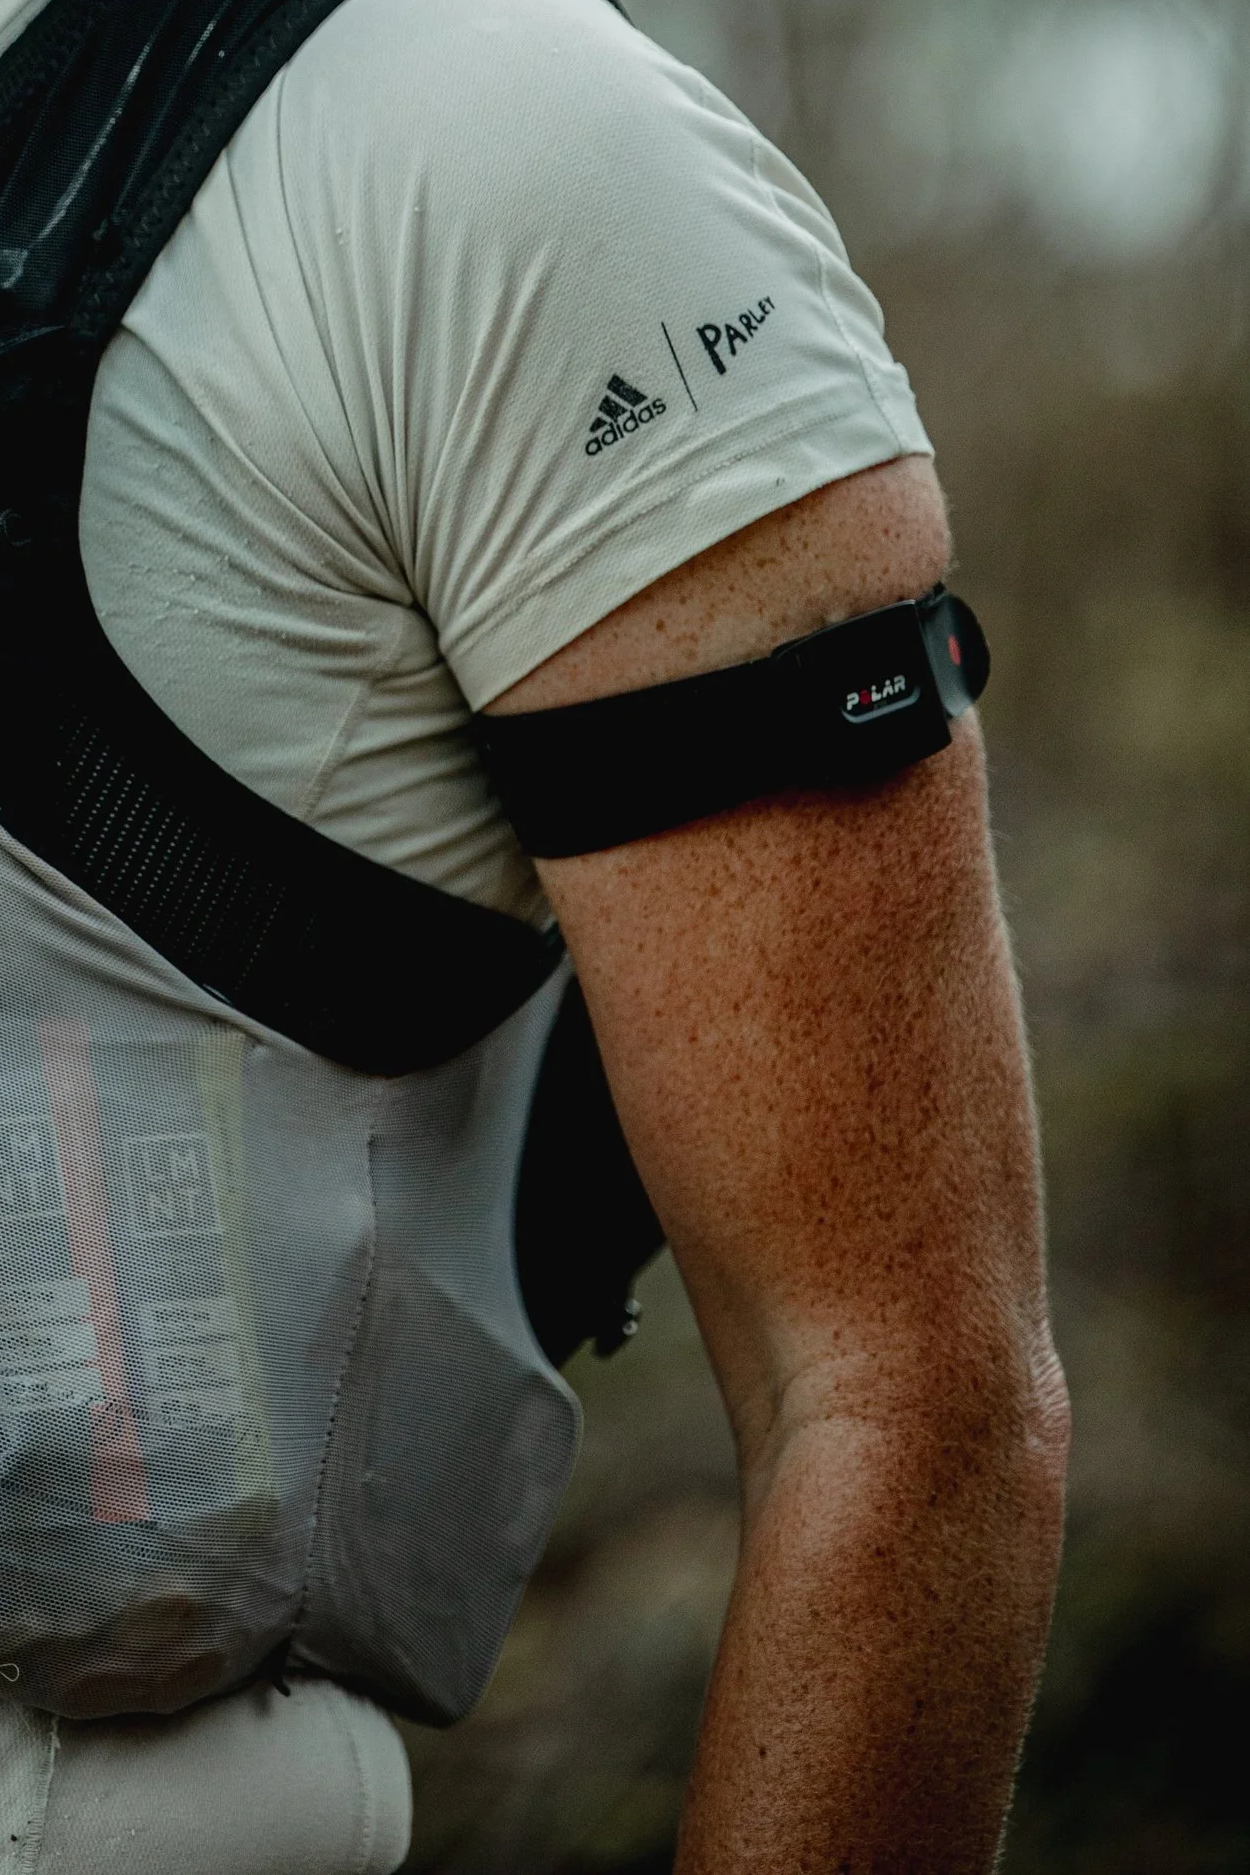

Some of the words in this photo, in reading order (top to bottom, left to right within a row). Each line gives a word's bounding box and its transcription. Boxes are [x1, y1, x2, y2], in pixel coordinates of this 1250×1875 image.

[696, 295, 776, 375] PARLEY
[585, 397, 667, 456] adidas
[846, 675, 906, 710] POLAR
